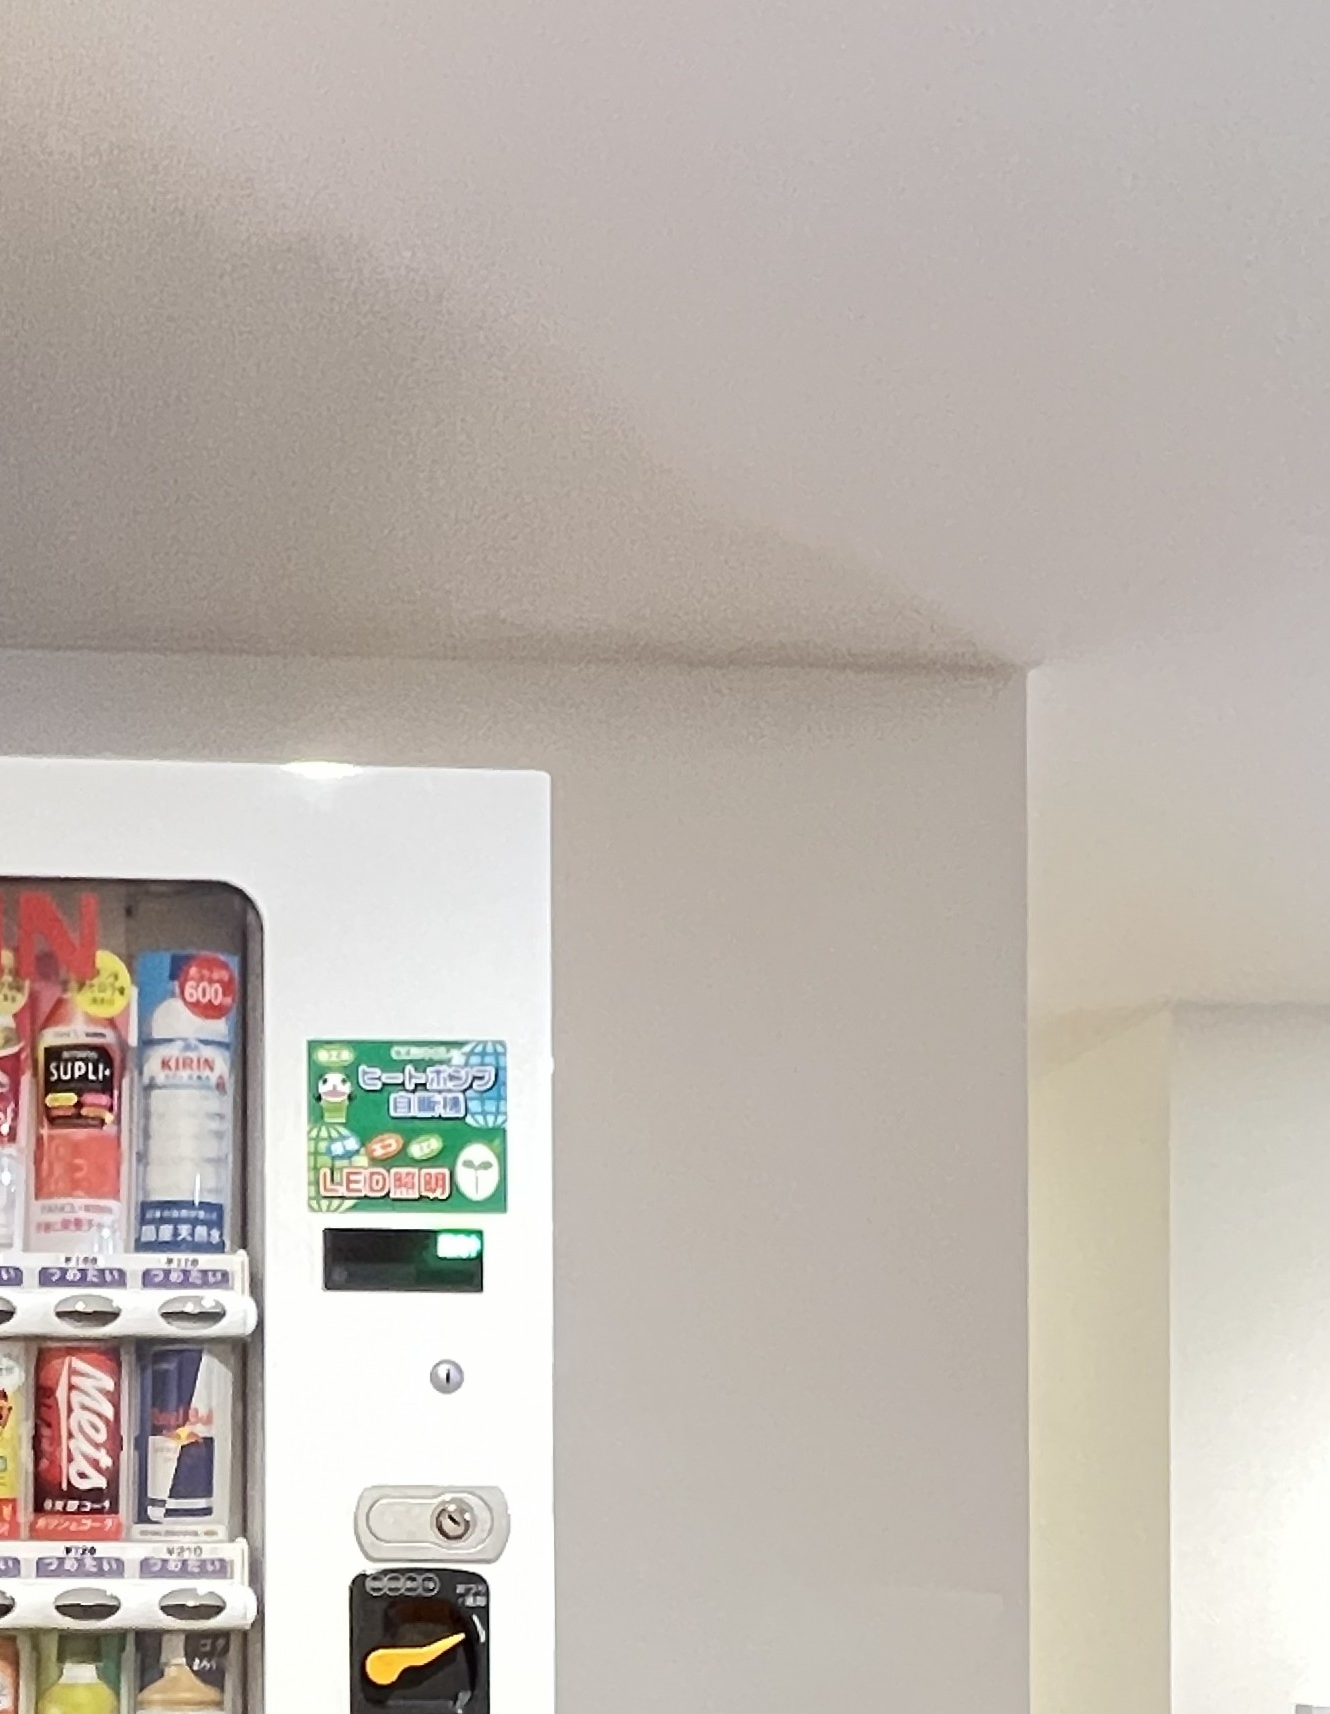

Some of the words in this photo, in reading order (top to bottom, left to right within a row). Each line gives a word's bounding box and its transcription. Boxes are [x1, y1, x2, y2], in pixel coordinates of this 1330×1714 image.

[160, 1055, 216, 1072] KIRIN
[319, 1167, 452, 1200] LED照明
[48, 1267, 120, 1282] つめたい
[150, 1268, 222, 1283] つめたい
[69, 1355, 117, 1490] Mets
[45, 1558, 118, 1573] つめたい
[149, 1559, 221, 1573] つめたい
